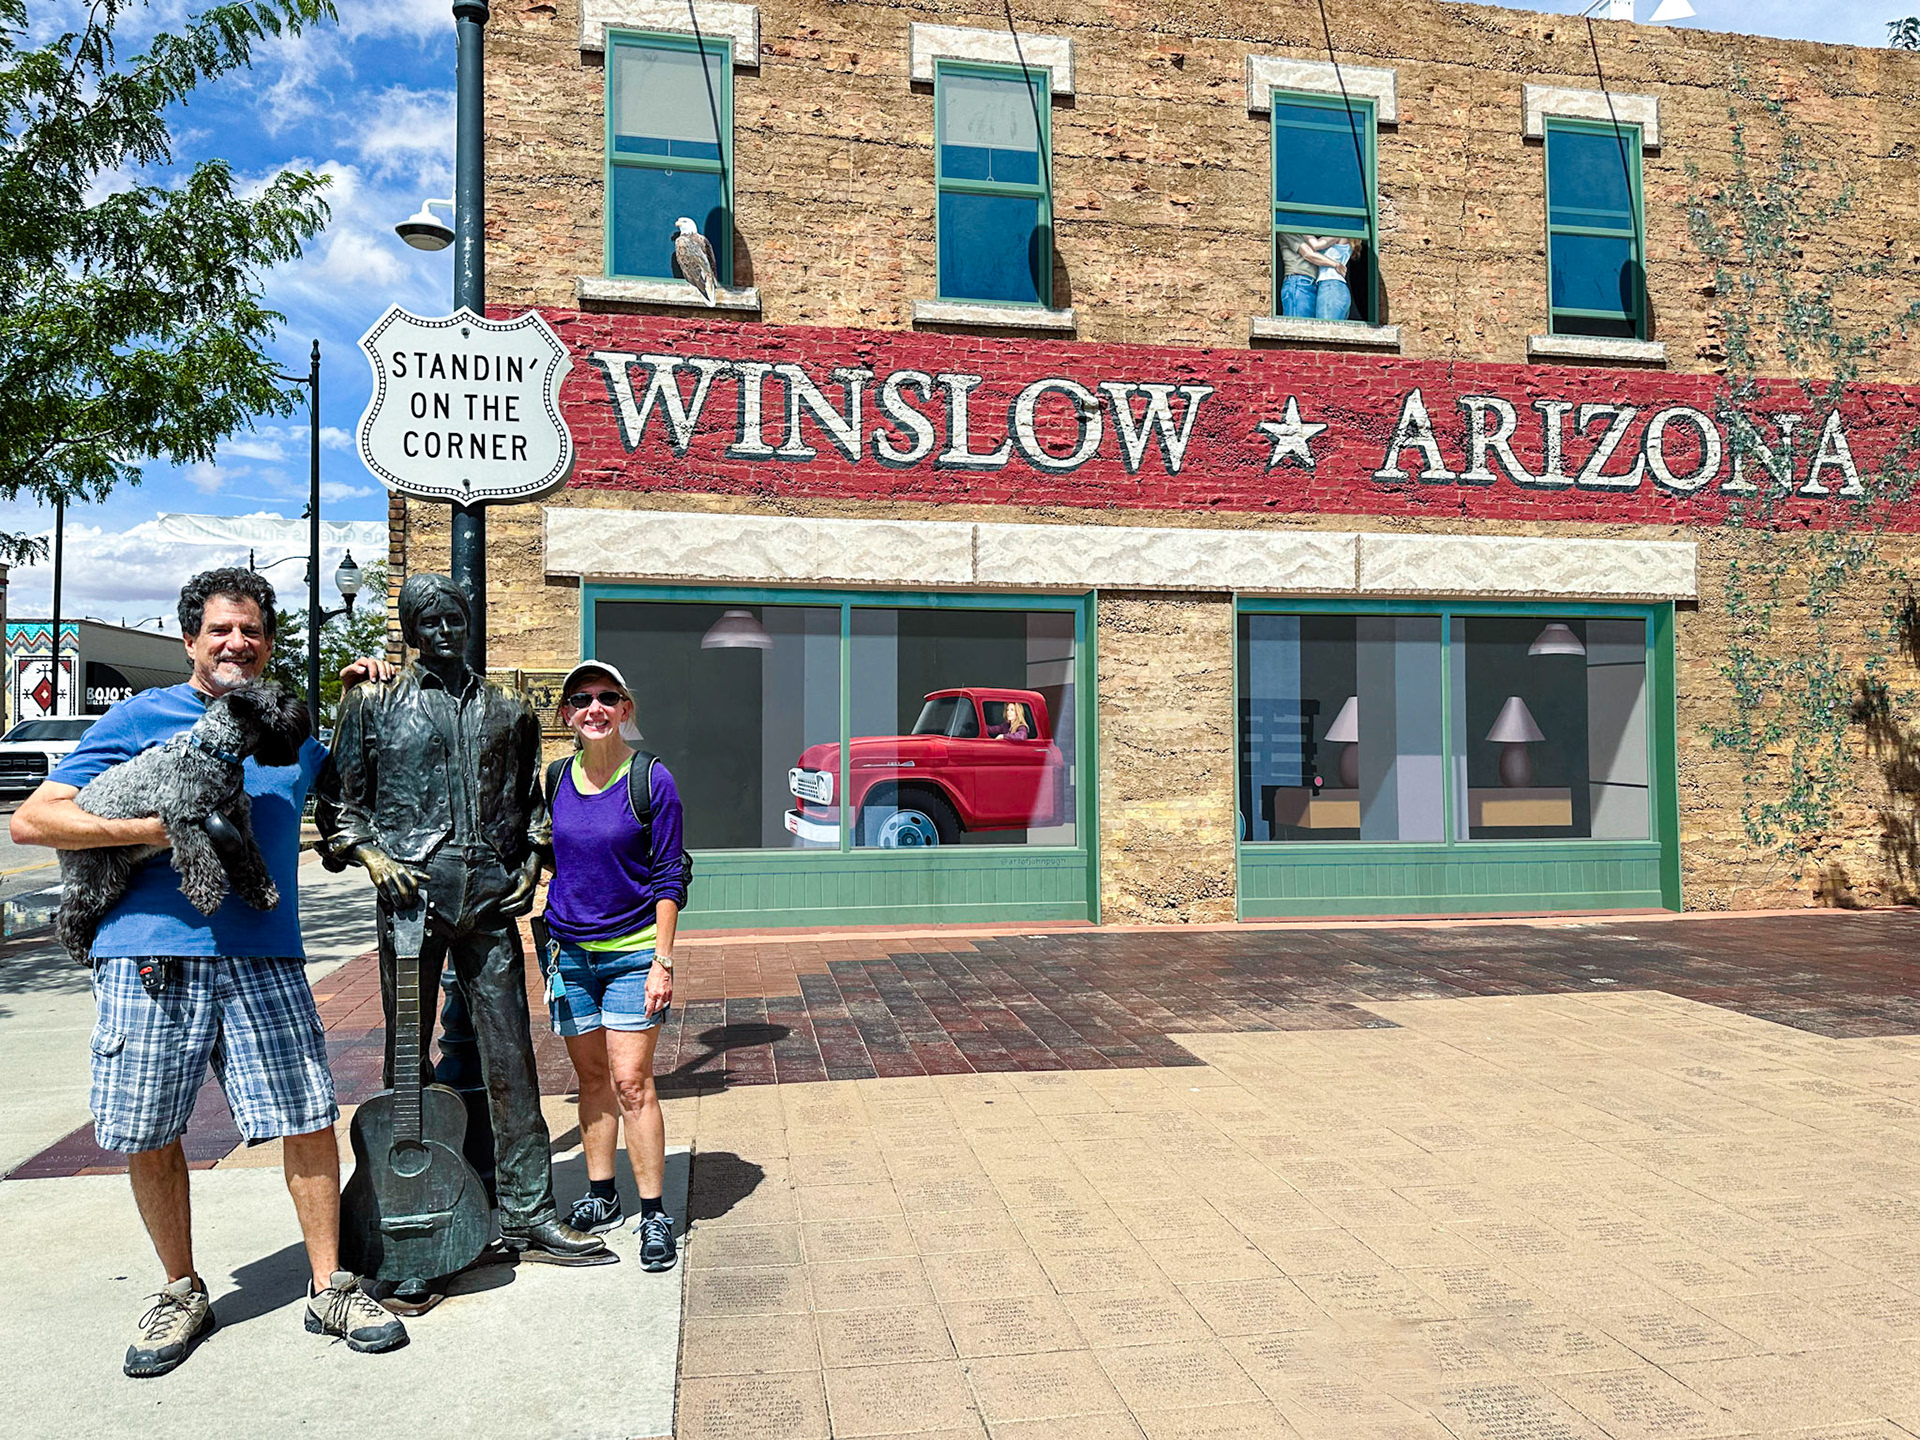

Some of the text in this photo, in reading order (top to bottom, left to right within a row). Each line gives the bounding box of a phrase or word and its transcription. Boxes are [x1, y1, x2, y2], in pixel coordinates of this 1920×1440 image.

[392, 351, 538, 383] STANDIN'
[411, 392, 520, 422] ON THE
[587, 350, 1866, 500] WINSLOW ARIZONA
[403, 431, 527, 461] CORNER
[86, 686, 133, 701] BOJO'S
[0, 758, 46, 766] ORD
